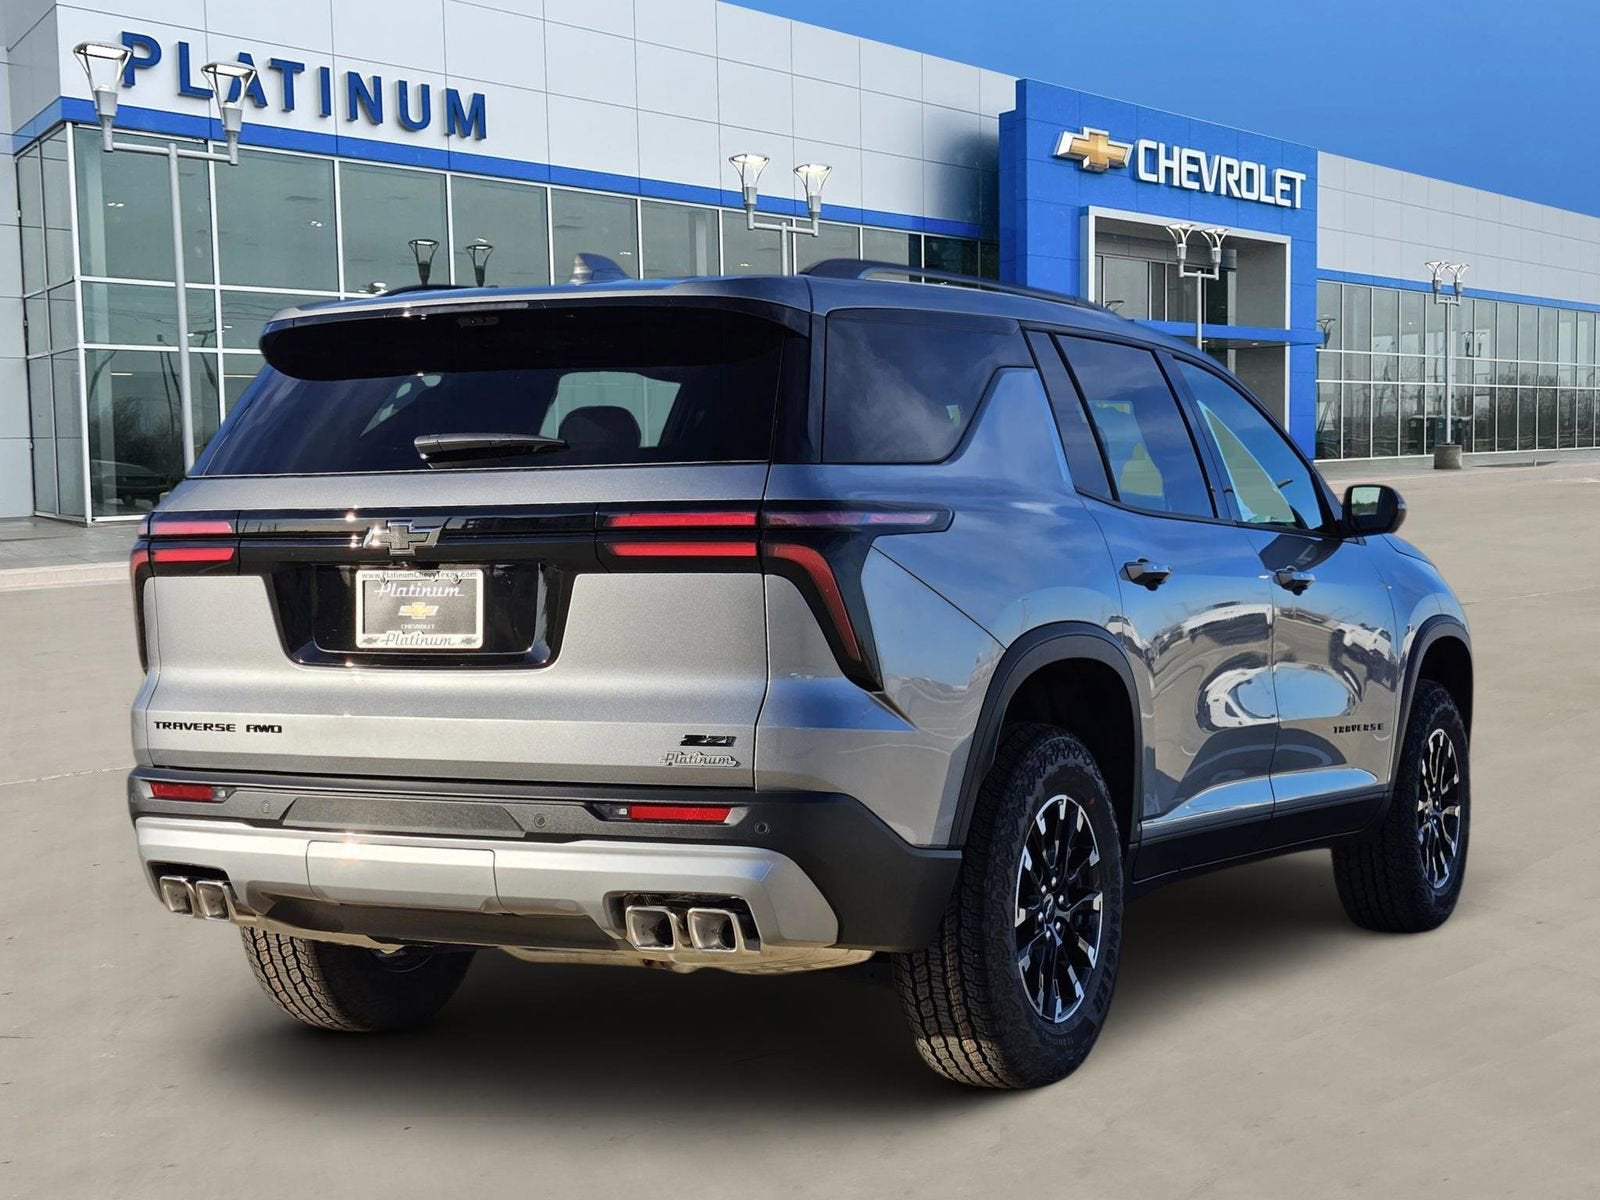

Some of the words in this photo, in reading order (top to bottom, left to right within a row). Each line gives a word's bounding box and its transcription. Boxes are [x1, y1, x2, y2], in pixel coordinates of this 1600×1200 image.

[121, 31, 487, 140] PLATINUM
[1136, 138, 1307, 209] CHEVROLET
[374, 582, 465, 598] Platinum
[380, 633, 458, 646] Platinum
[154, 721, 237, 733] TRAVERSE
[245, 724, 283, 734] AWD
[1333, 723, 1385, 734] TRAVERSE
[680, 734, 738, 748] Z71
[659, 750, 742, 768] Platinum
